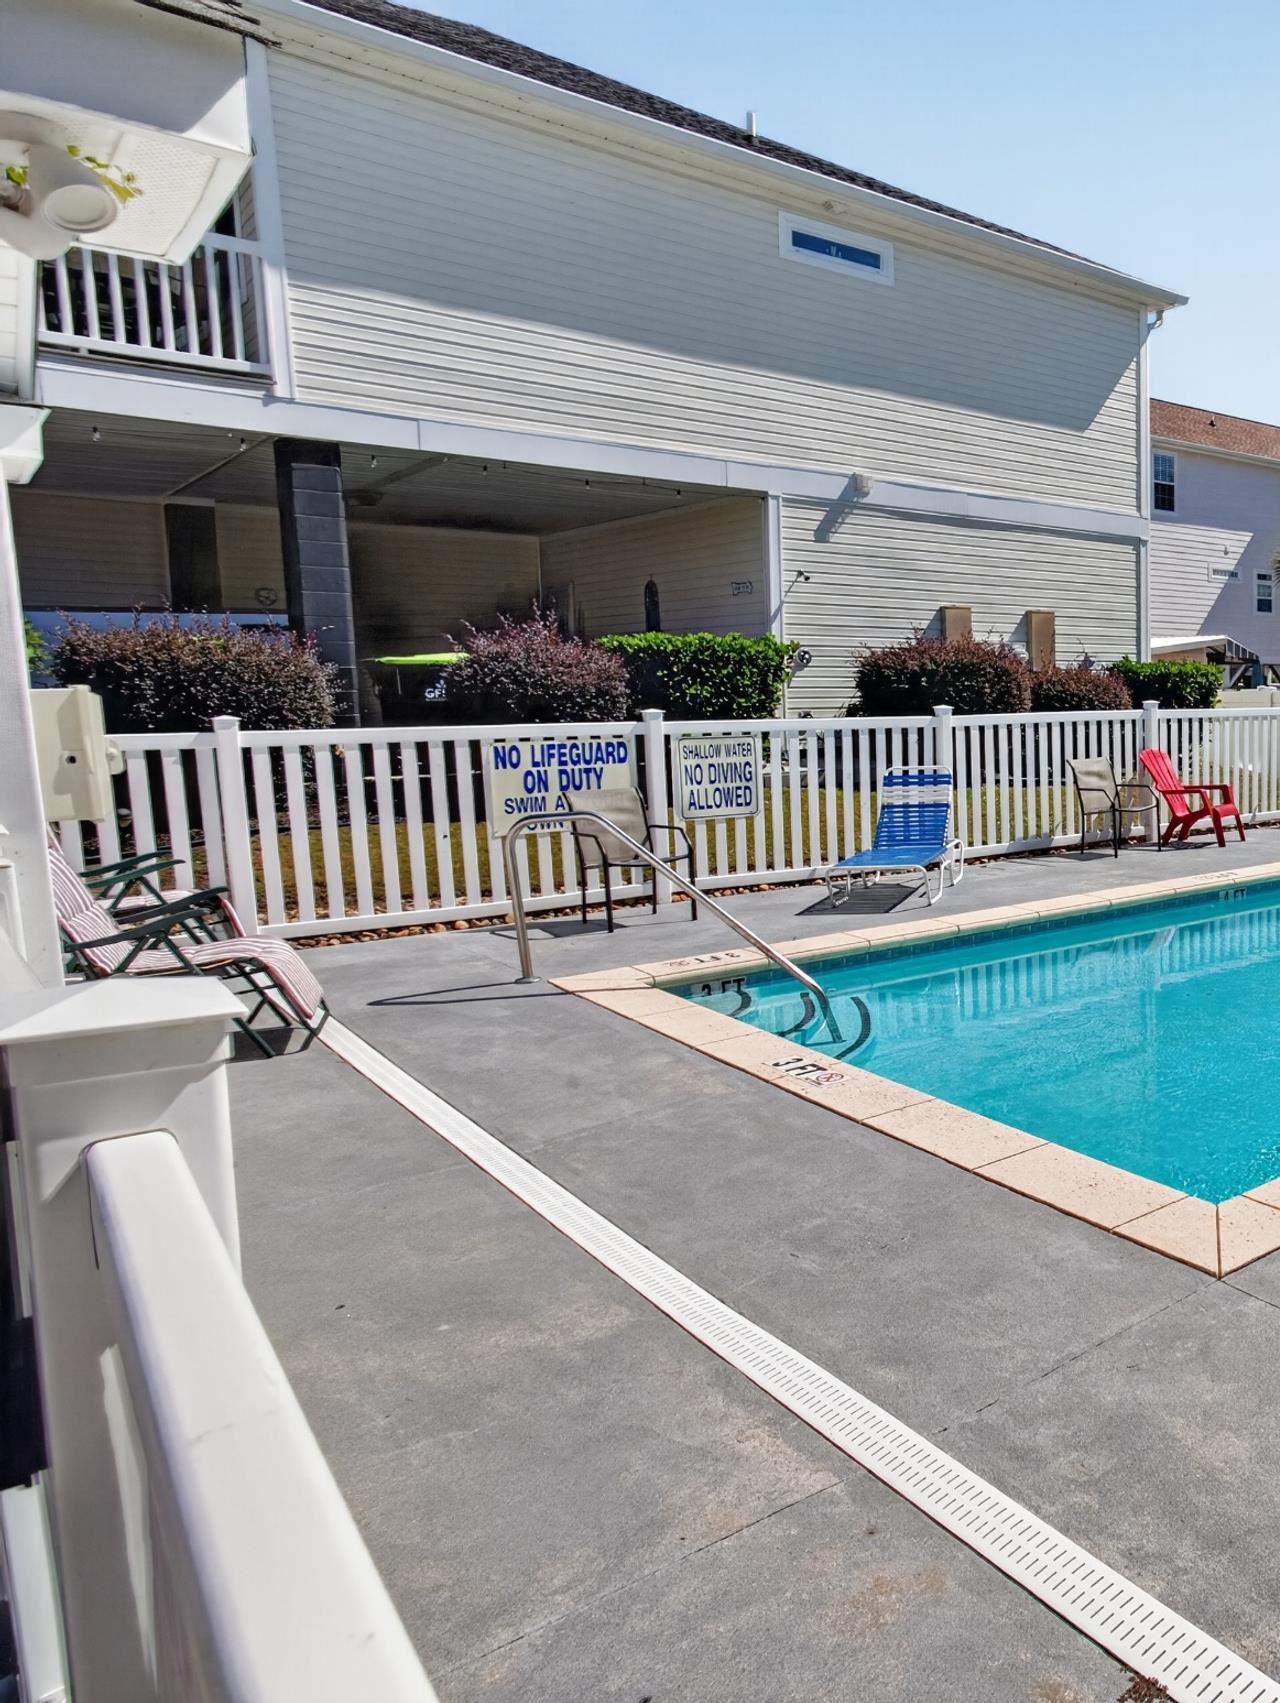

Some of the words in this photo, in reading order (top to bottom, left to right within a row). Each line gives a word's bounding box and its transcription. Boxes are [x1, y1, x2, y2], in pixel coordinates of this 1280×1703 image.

[493, 744, 521, 770] NO
[530, 741, 628, 768] LIFEGUARD
[682, 744, 722, 760] SHALLOW
[724, 742, 752, 758] WATER
[523, 769, 549, 794] ON
[558, 767, 604, 792] DUTY
[684, 763, 703, 786] NO
[708, 761, 753, 785] DIVING
[504, 796, 547, 815] SWIM
[555, 795, 566, 811] A
[688, 785, 752, 811] ALLOWED
[772, 1057, 803, 1067] 3
[785, 1063, 827, 1076] FT
